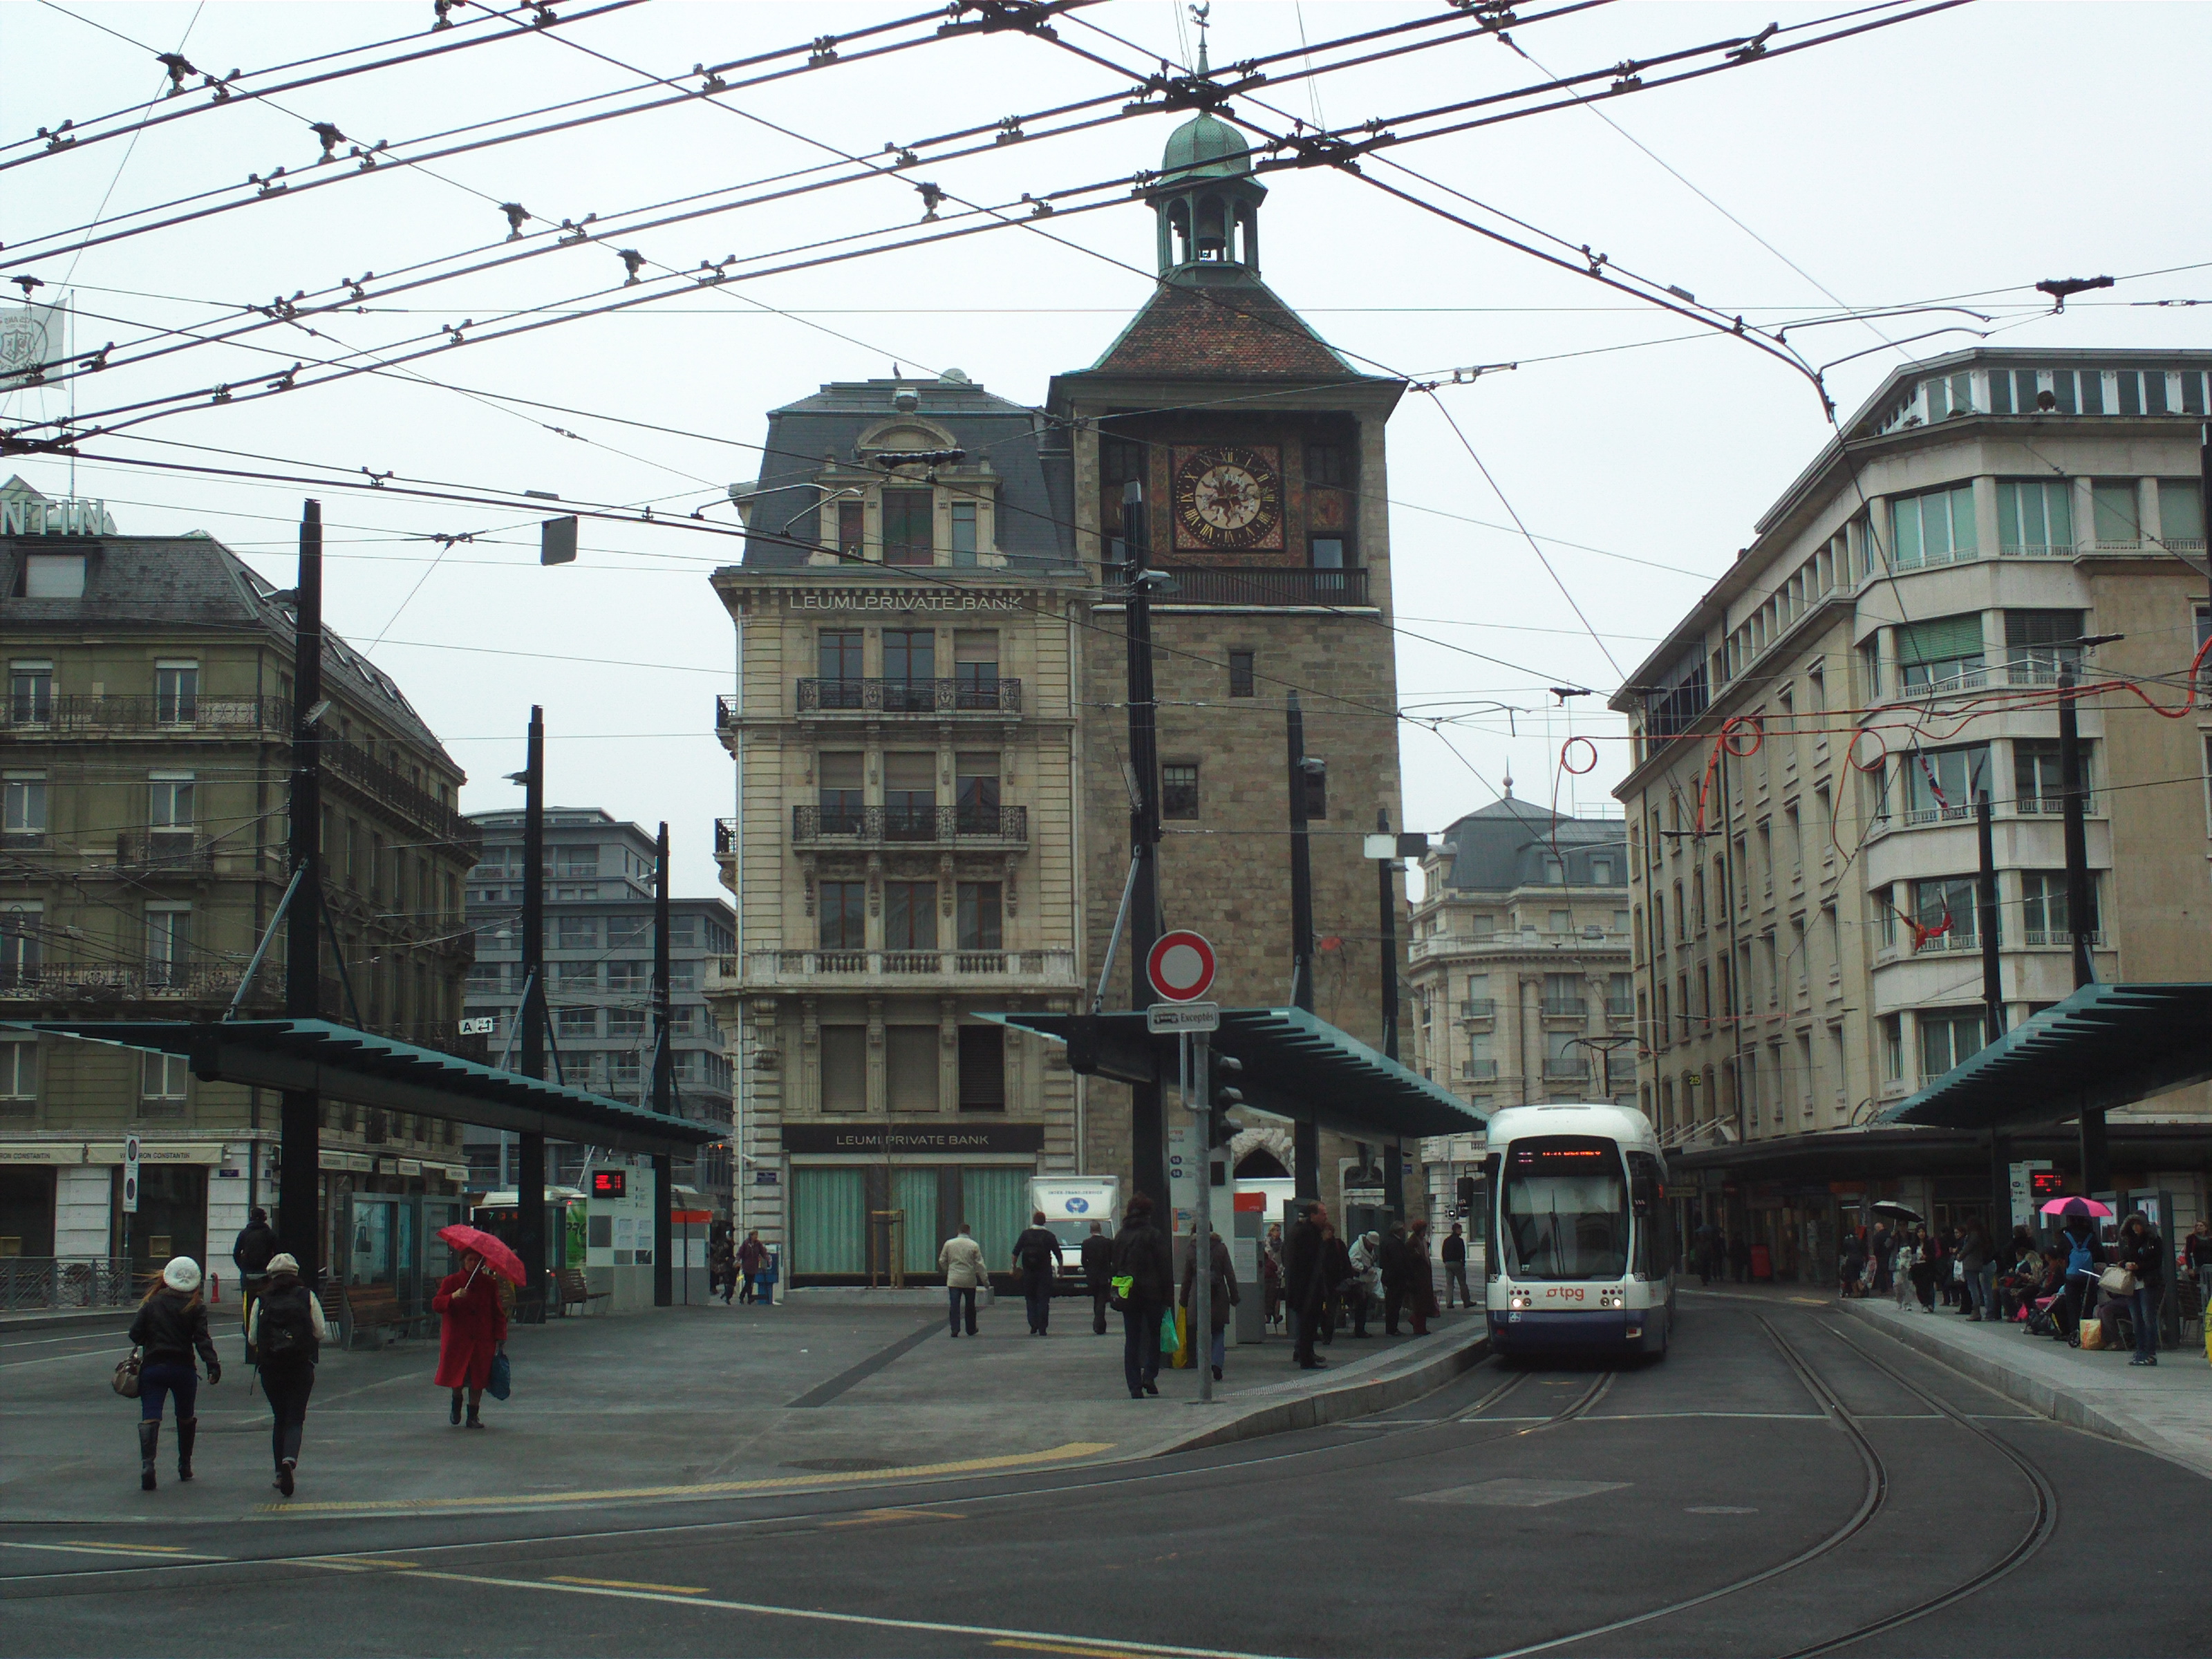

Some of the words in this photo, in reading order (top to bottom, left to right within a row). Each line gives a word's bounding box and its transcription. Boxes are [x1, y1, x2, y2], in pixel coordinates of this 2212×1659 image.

[0, 498, 104, 536] NTIN
[789, 596, 858, 610] LEUMI
[864, 596, 955, 610] PRIVATE
[962, 596, 1023, 610] BANK
[1180, 1011, 1214, 1024] Exceptés
[463, 1022, 472, 1032] A
[836, 1135, 881, 1145] LEUMI
[885, 1135, 945, 1145] PRIVATE
[948, 1135, 989, 1145] BANK
